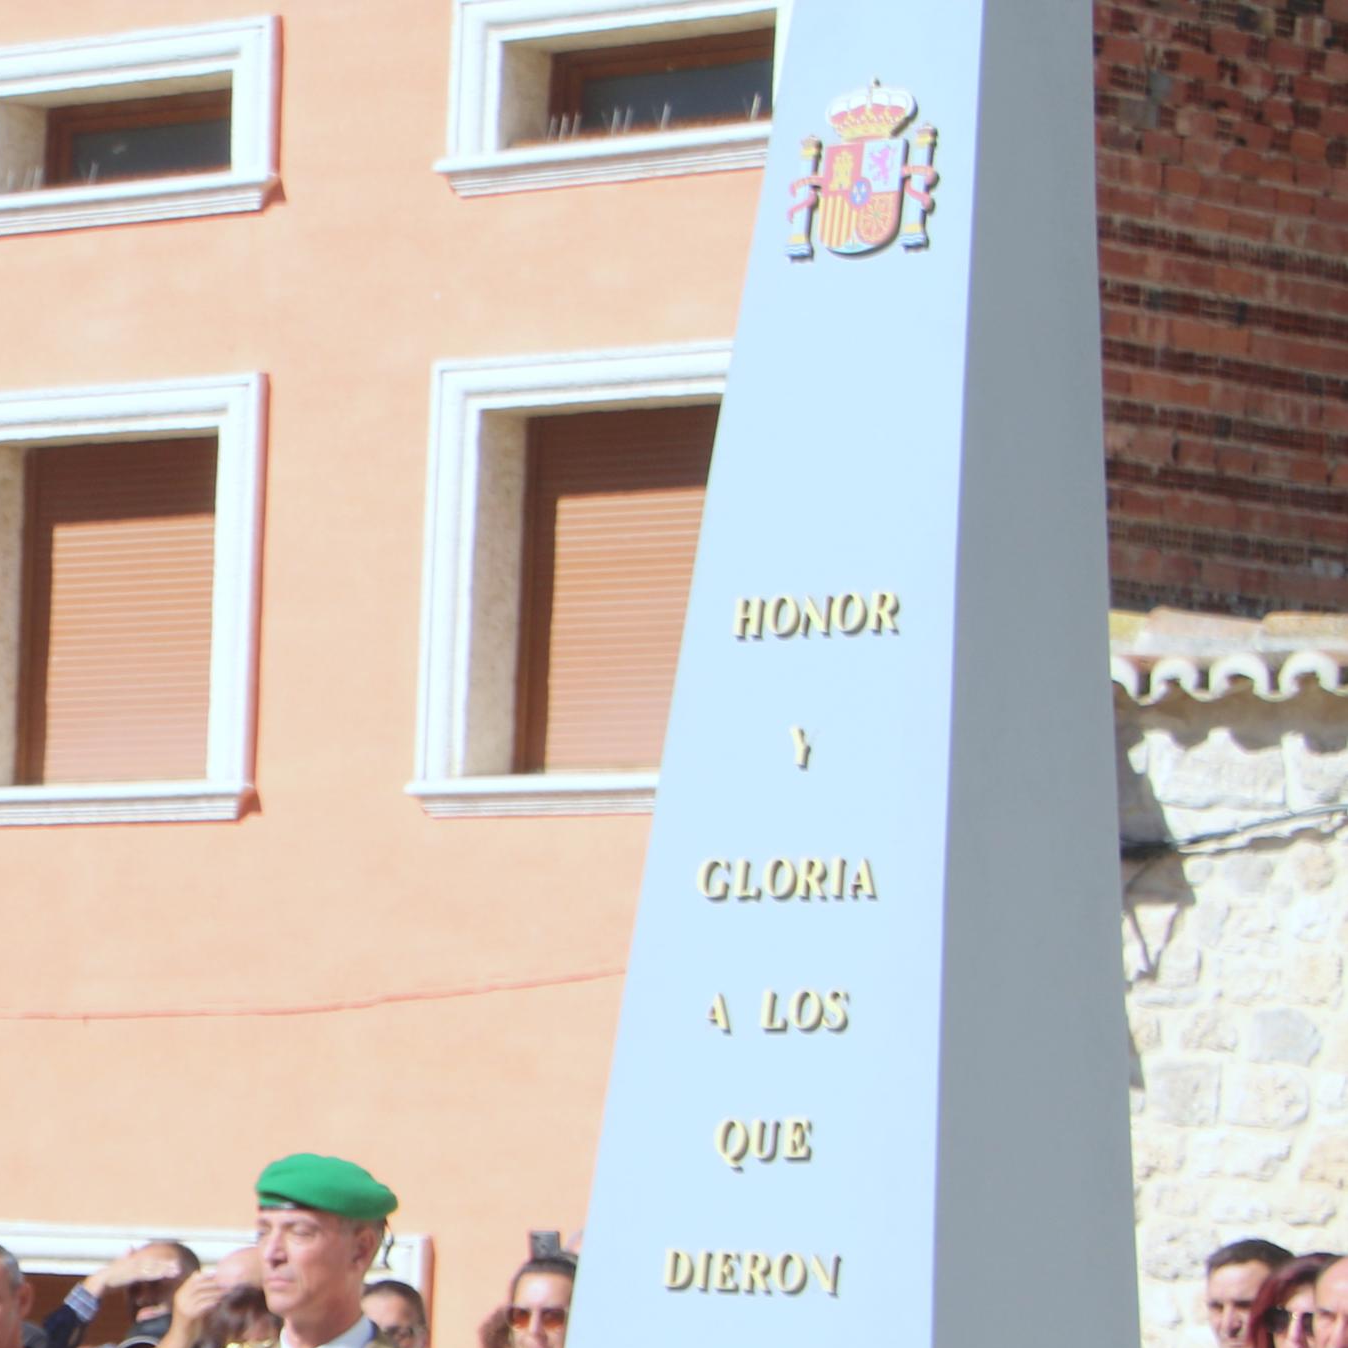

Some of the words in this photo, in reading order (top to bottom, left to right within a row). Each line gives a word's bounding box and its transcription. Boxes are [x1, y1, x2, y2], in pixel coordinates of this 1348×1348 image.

[733, 591, 901, 641] HONOR
[696, 857, 878, 903] GLORIA
[708, 992, 733, 1035] A
[760, 989, 850, 1033] LOS
[715, 1117, 813, 1173] QUE
[665, 1249, 842, 1299] DIERON
